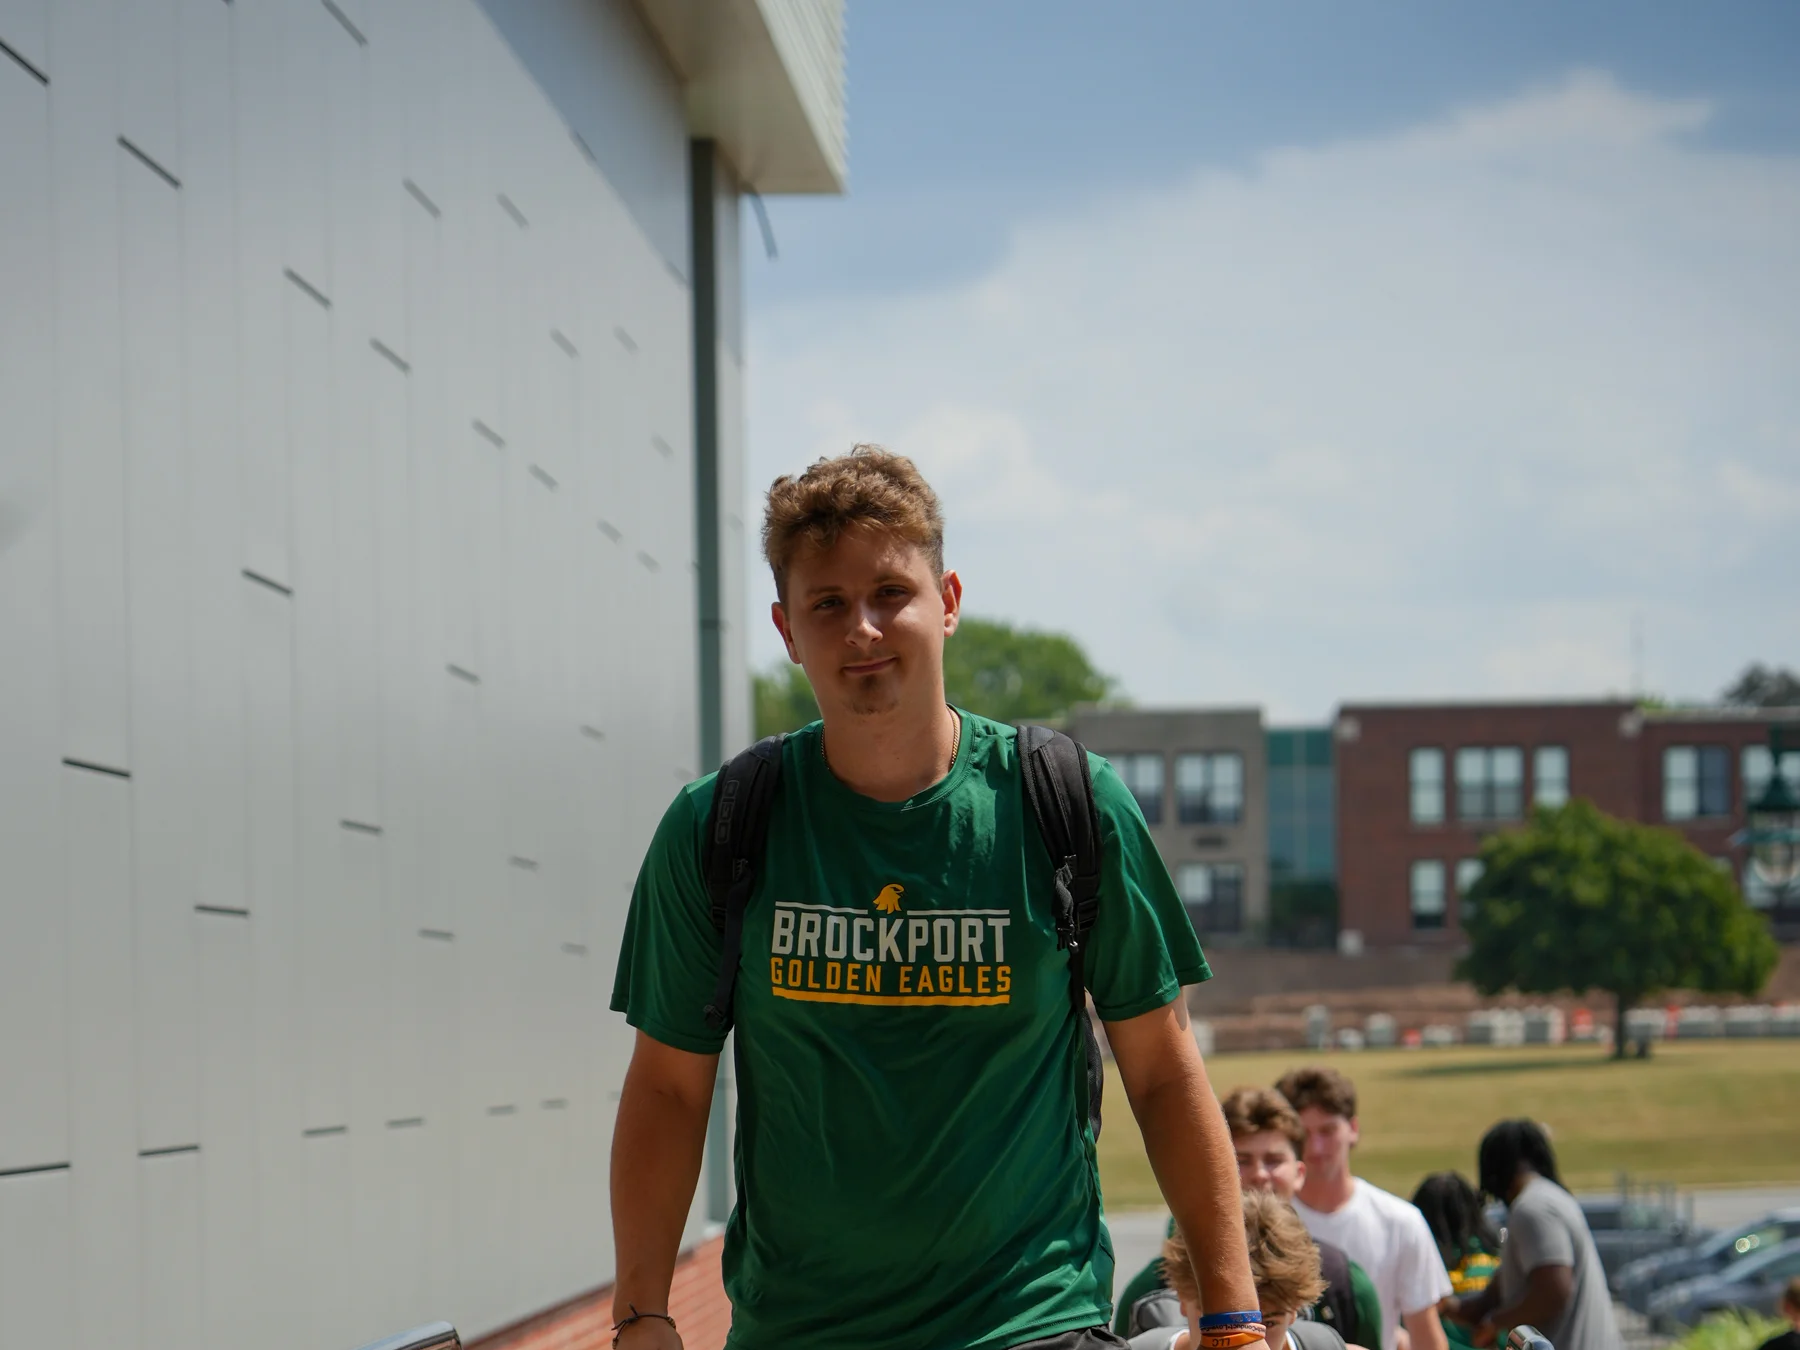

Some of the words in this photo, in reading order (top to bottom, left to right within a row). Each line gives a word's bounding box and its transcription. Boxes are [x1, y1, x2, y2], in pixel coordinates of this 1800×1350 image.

[771, 909, 1011, 963] BROCKPORT
[770, 957, 882, 993] GOLDEN
[900, 965, 1012, 994] EAGLES
[1212, 1338, 1230, 1347] LLC
